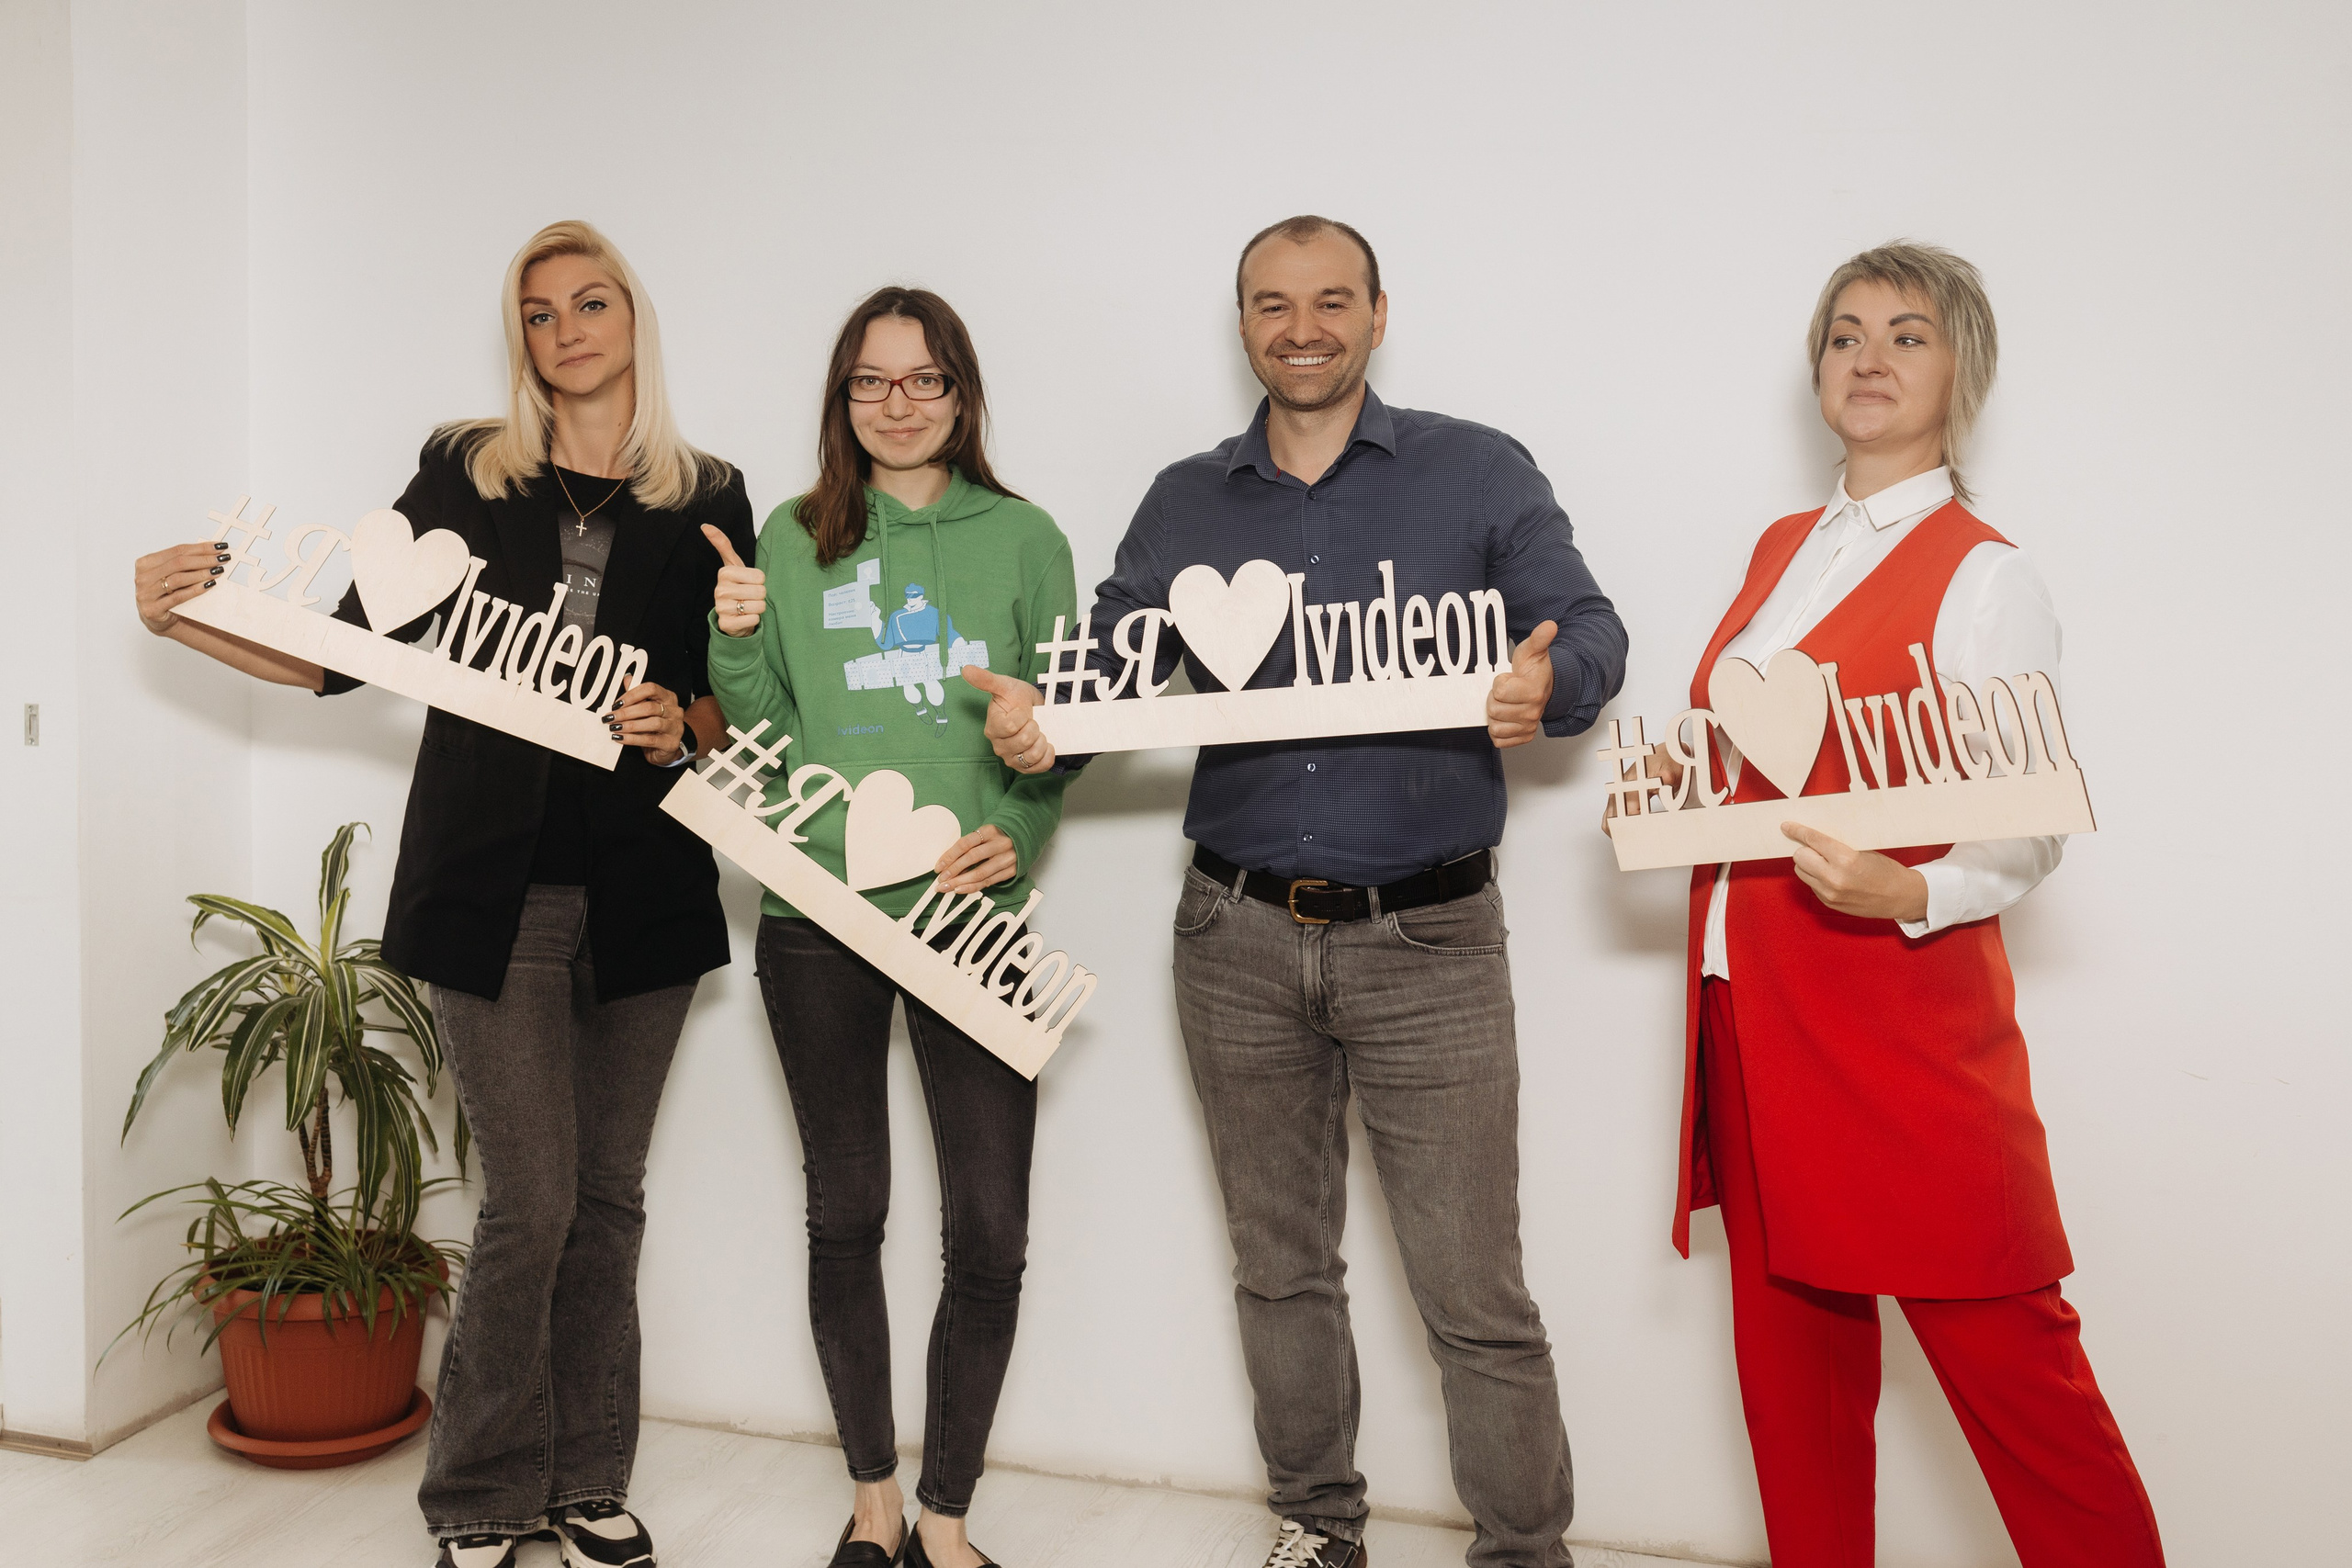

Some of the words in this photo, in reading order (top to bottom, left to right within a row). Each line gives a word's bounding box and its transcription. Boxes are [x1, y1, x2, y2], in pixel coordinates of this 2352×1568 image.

[1287, 559, 1512, 686] Ivideon
[837, 723, 884, 736] ivideon
[1819, 642, 2082, 793] Ivideon
